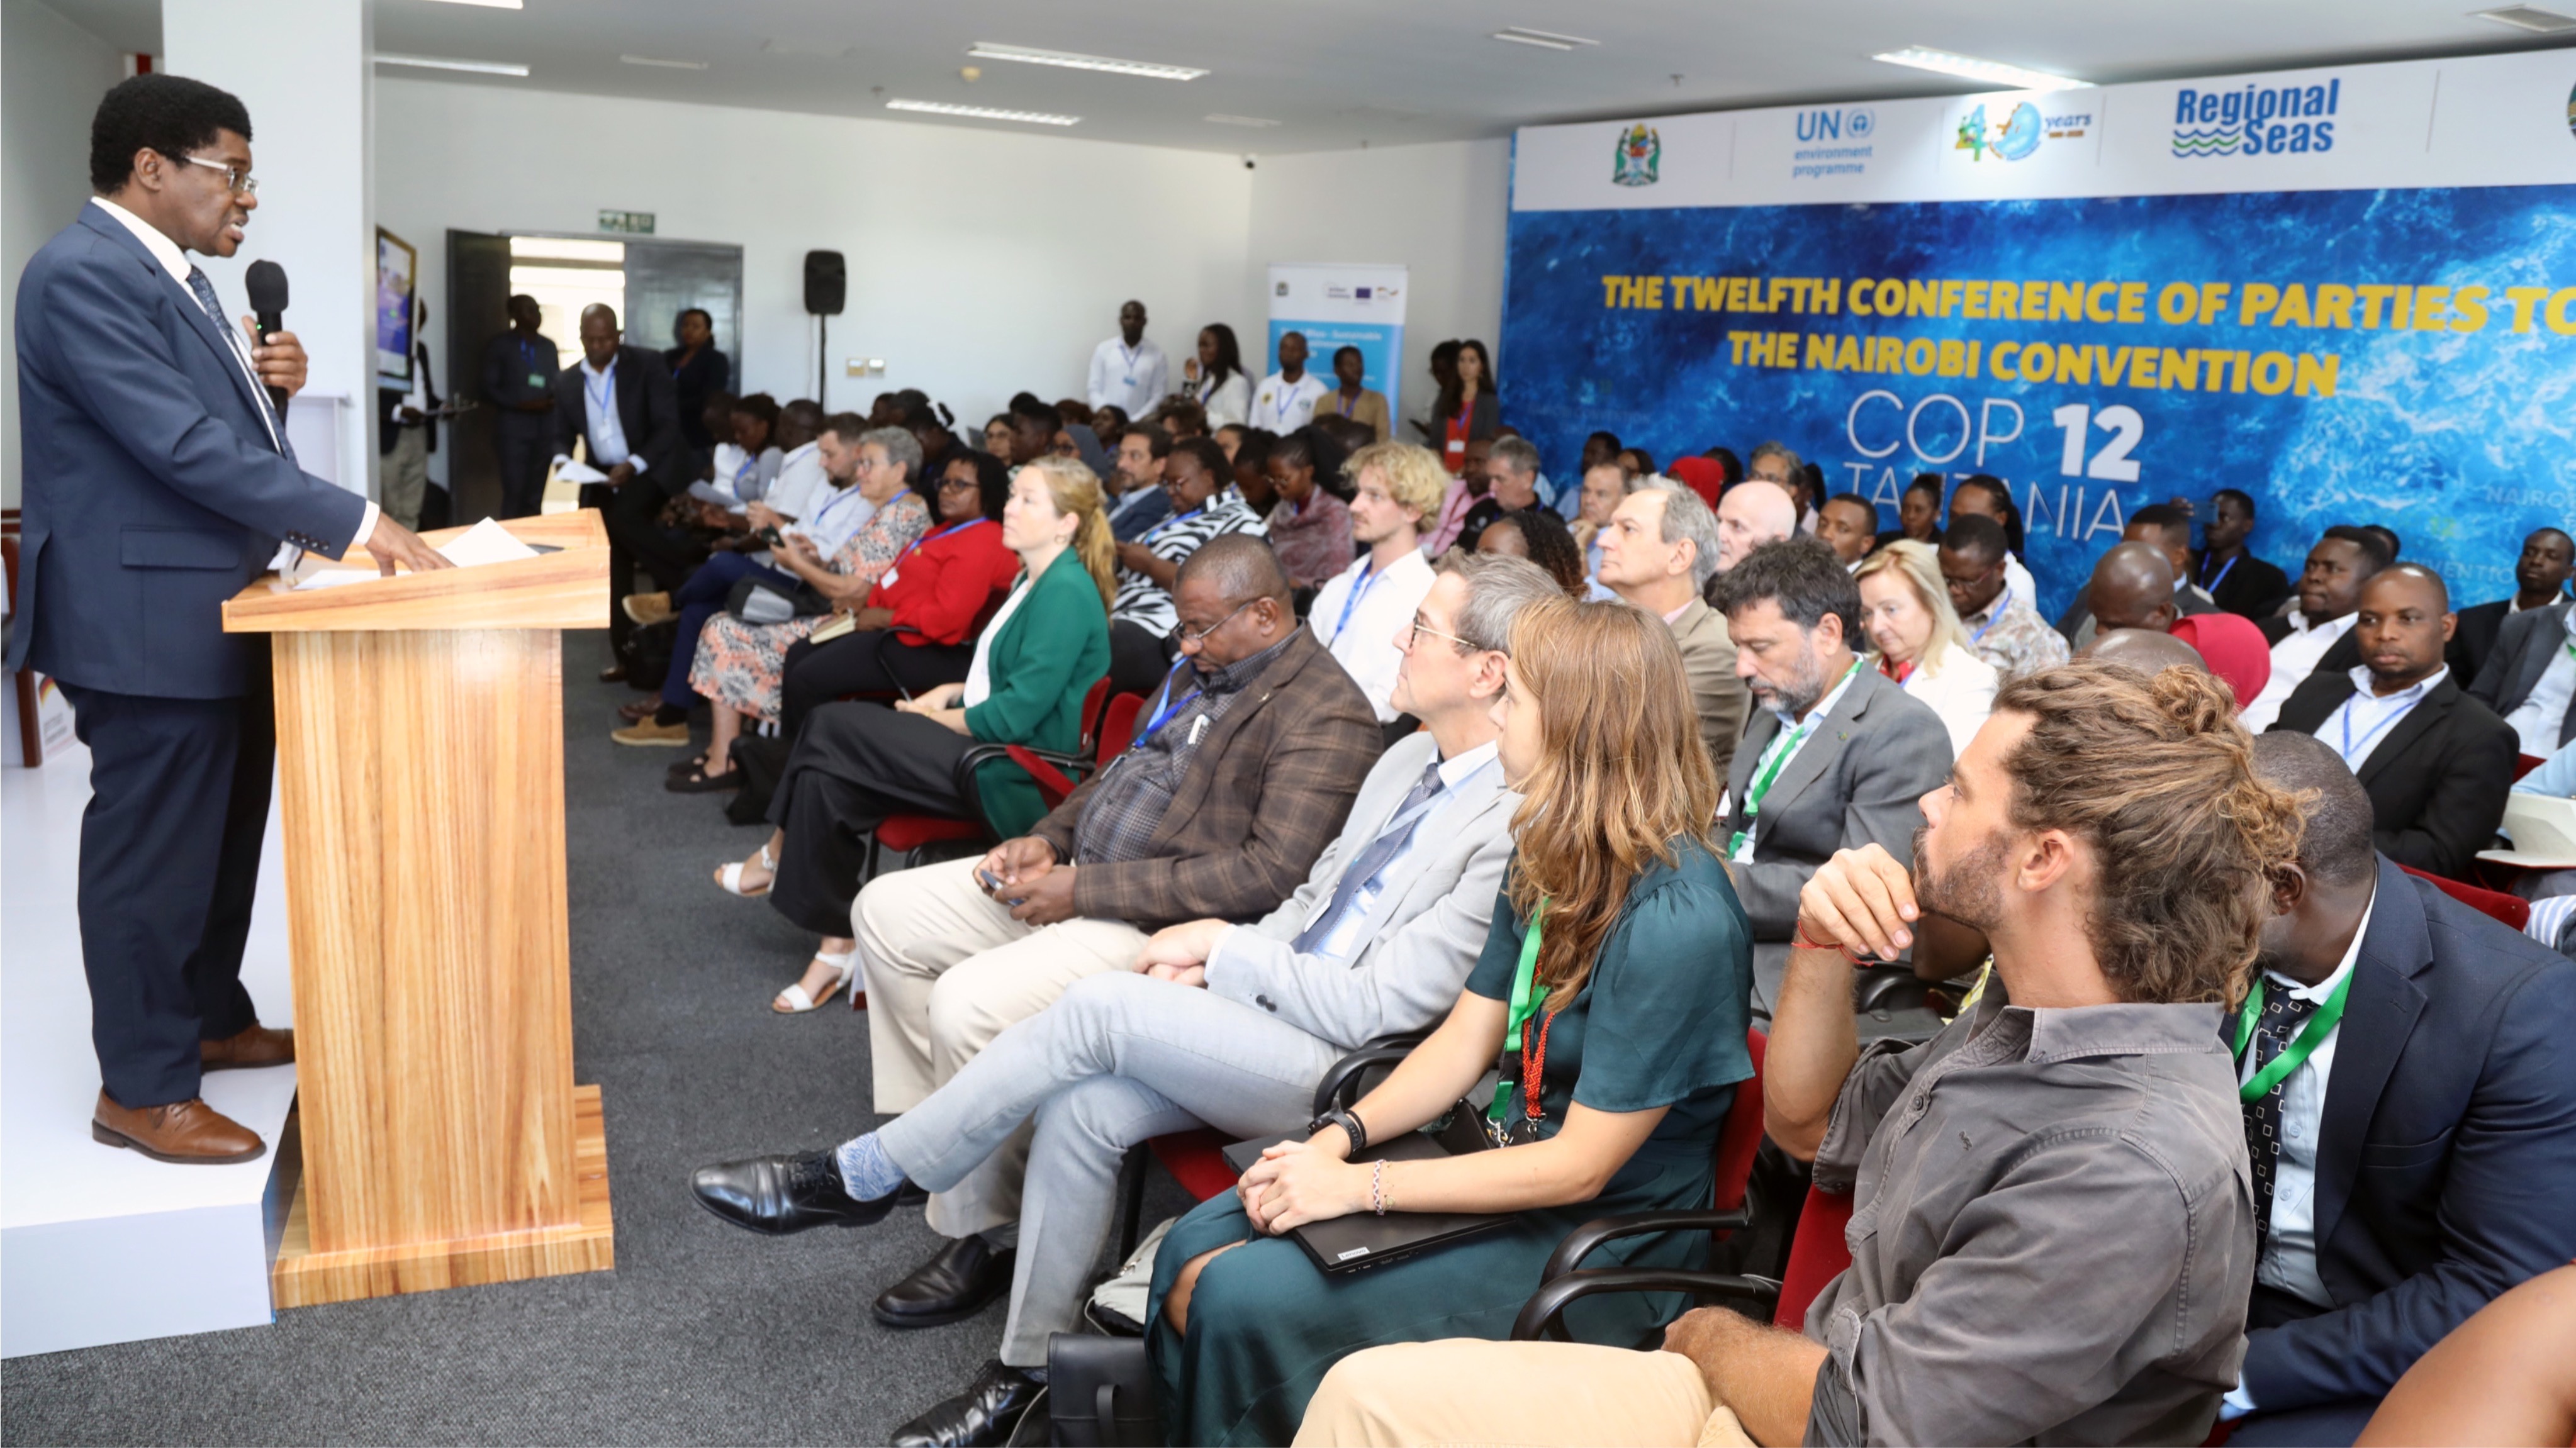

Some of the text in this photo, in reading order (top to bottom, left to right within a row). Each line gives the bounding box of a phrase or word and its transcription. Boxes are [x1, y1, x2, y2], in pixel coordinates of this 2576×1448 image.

[2176, 78, 2340, 126] Regional
[1798, 109, 1842, 142] UN
[2044, 114, 2093, 133] years
[2243, 118, 2334, 156] Seas
[1793, 163, 1865, 179] programme
[1795, 145, 1873, 160] environment
[1602, 276, 1664, 309] THE
[1671, 276, 1840, 314] TWELFTH
[1847, 277, 2148, 323] CONFERENCE
[2157, 282, 2231, 325] OF
[2239, 283, 2491, 333] PARTIES
[1728, 331, 2340, 398] THE NAIROBI CONVENTION
[1847, 389, 2144, 483] COP 12
[1843, 462, 2124, 542] TANIA
[1341, 1249, 1367, 1259] Lenovo
